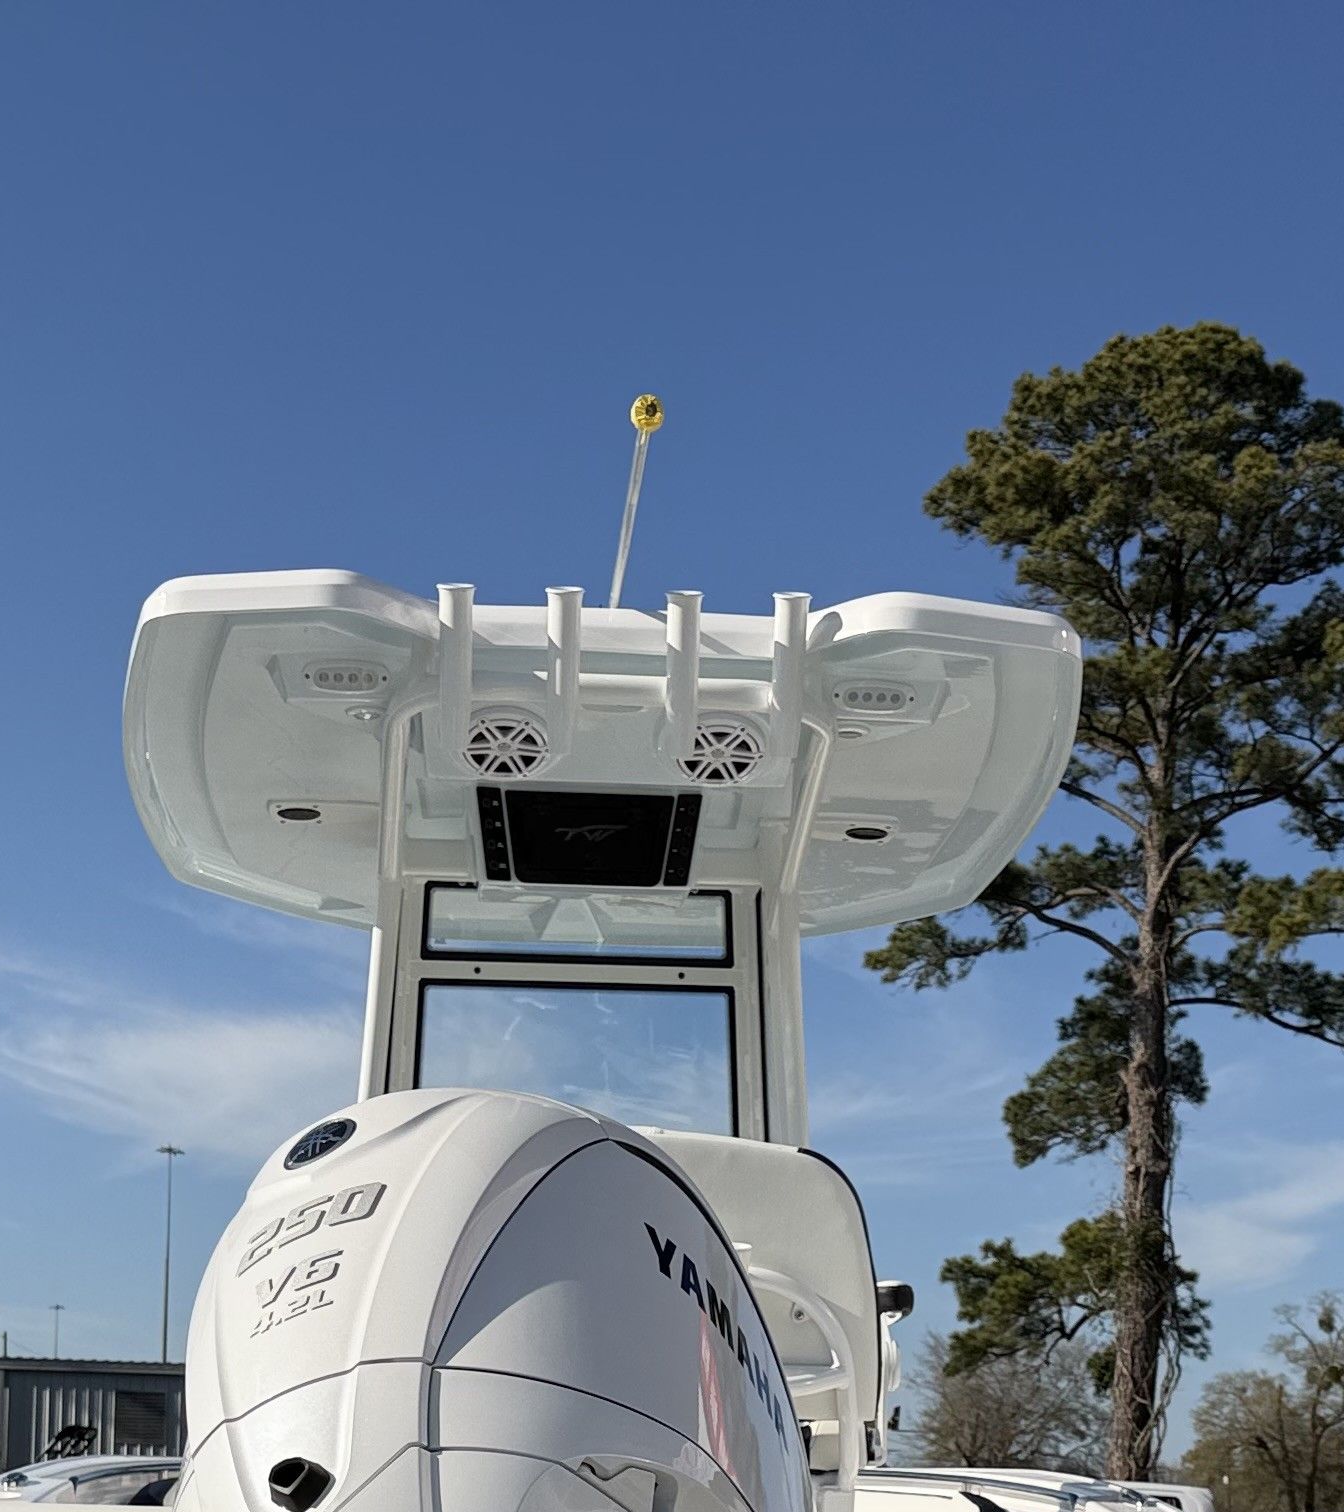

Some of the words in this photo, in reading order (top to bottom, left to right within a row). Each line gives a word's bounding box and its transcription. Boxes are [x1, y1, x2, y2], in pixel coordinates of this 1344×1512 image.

[235, 1181, 387, 1278] 250
[255, 1249, 344, 1309] V6
[644, 1222, 789, 1456] YAMAHA
